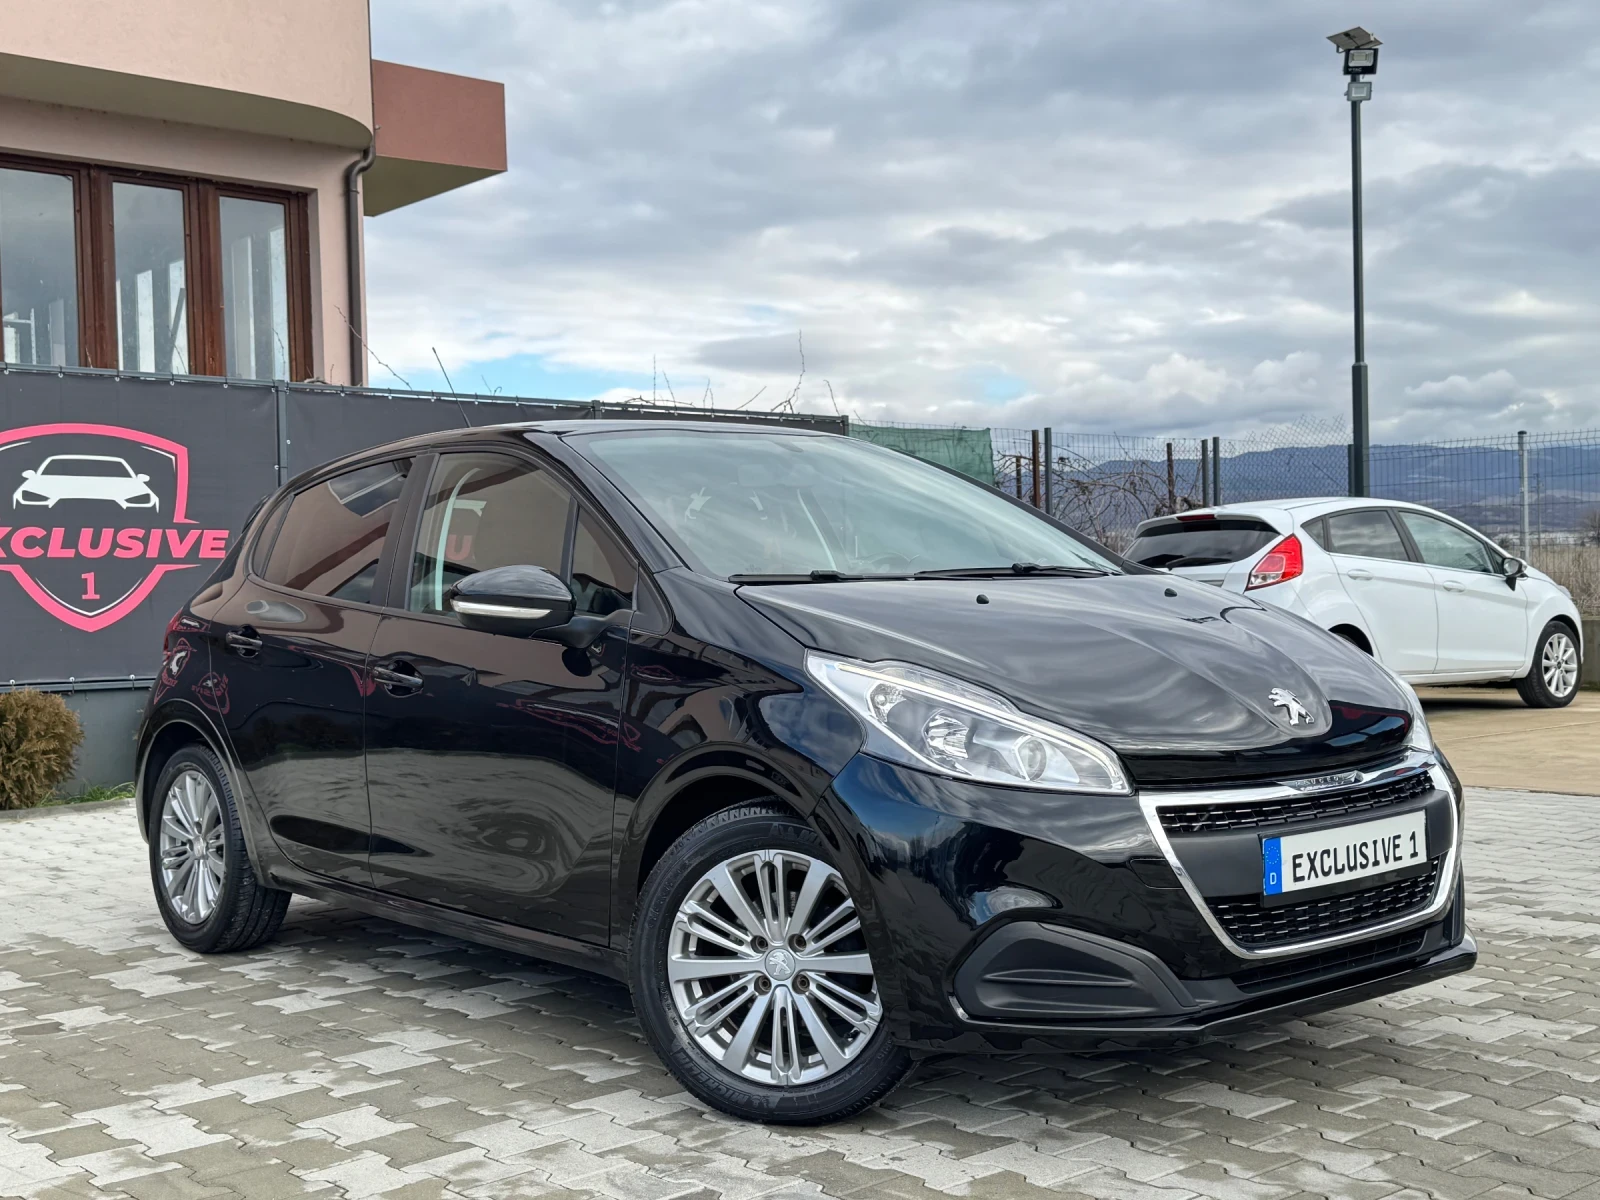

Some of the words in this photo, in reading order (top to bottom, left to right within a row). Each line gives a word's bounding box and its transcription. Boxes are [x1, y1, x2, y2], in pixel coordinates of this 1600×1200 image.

[81, 572, 100, 600] 1
[1292, 834, 1402, 883] EXCLUSIVE
[1409, 831, 1419, 859] 1
[1269, 872, 1277, 885] D
